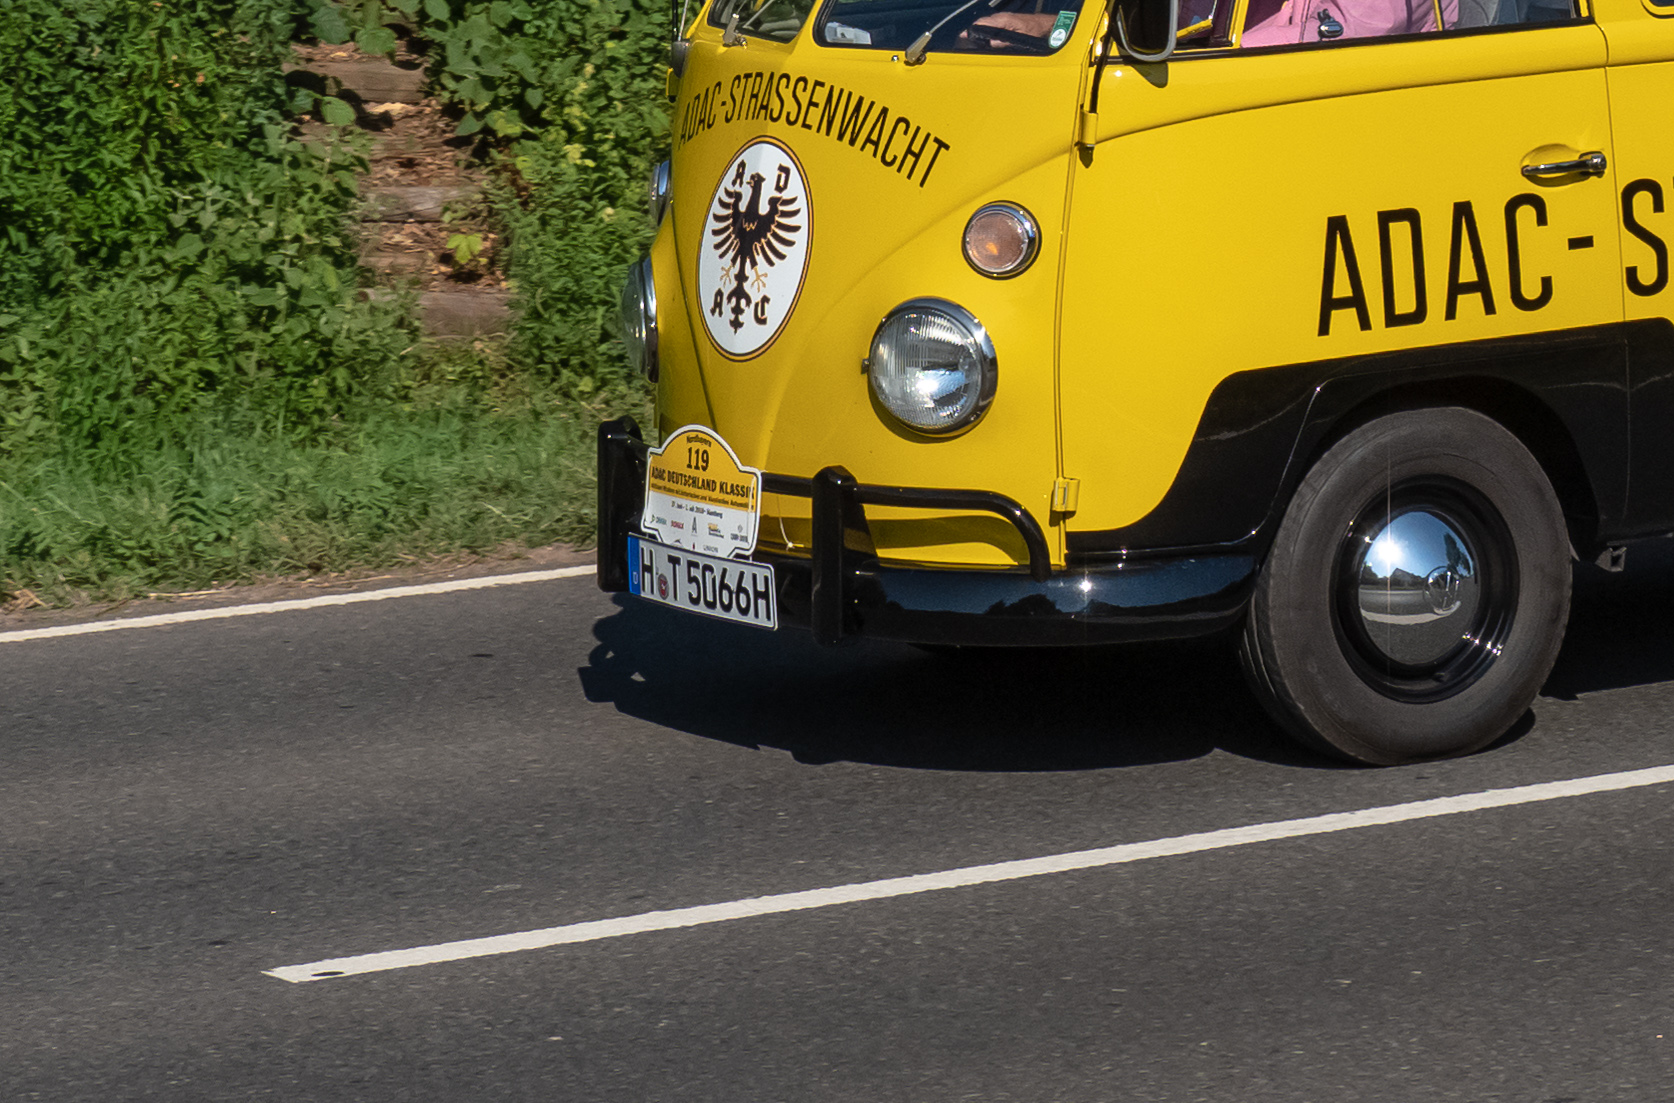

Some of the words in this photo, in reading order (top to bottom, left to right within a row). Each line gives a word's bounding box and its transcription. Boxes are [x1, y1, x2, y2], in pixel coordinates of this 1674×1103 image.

[678, 71, 951, 188] ADAC-STRASSENWACHT
[686, 446, 710, 472] 119
[667, 470, 717, 492] DEUTSCHLAND
